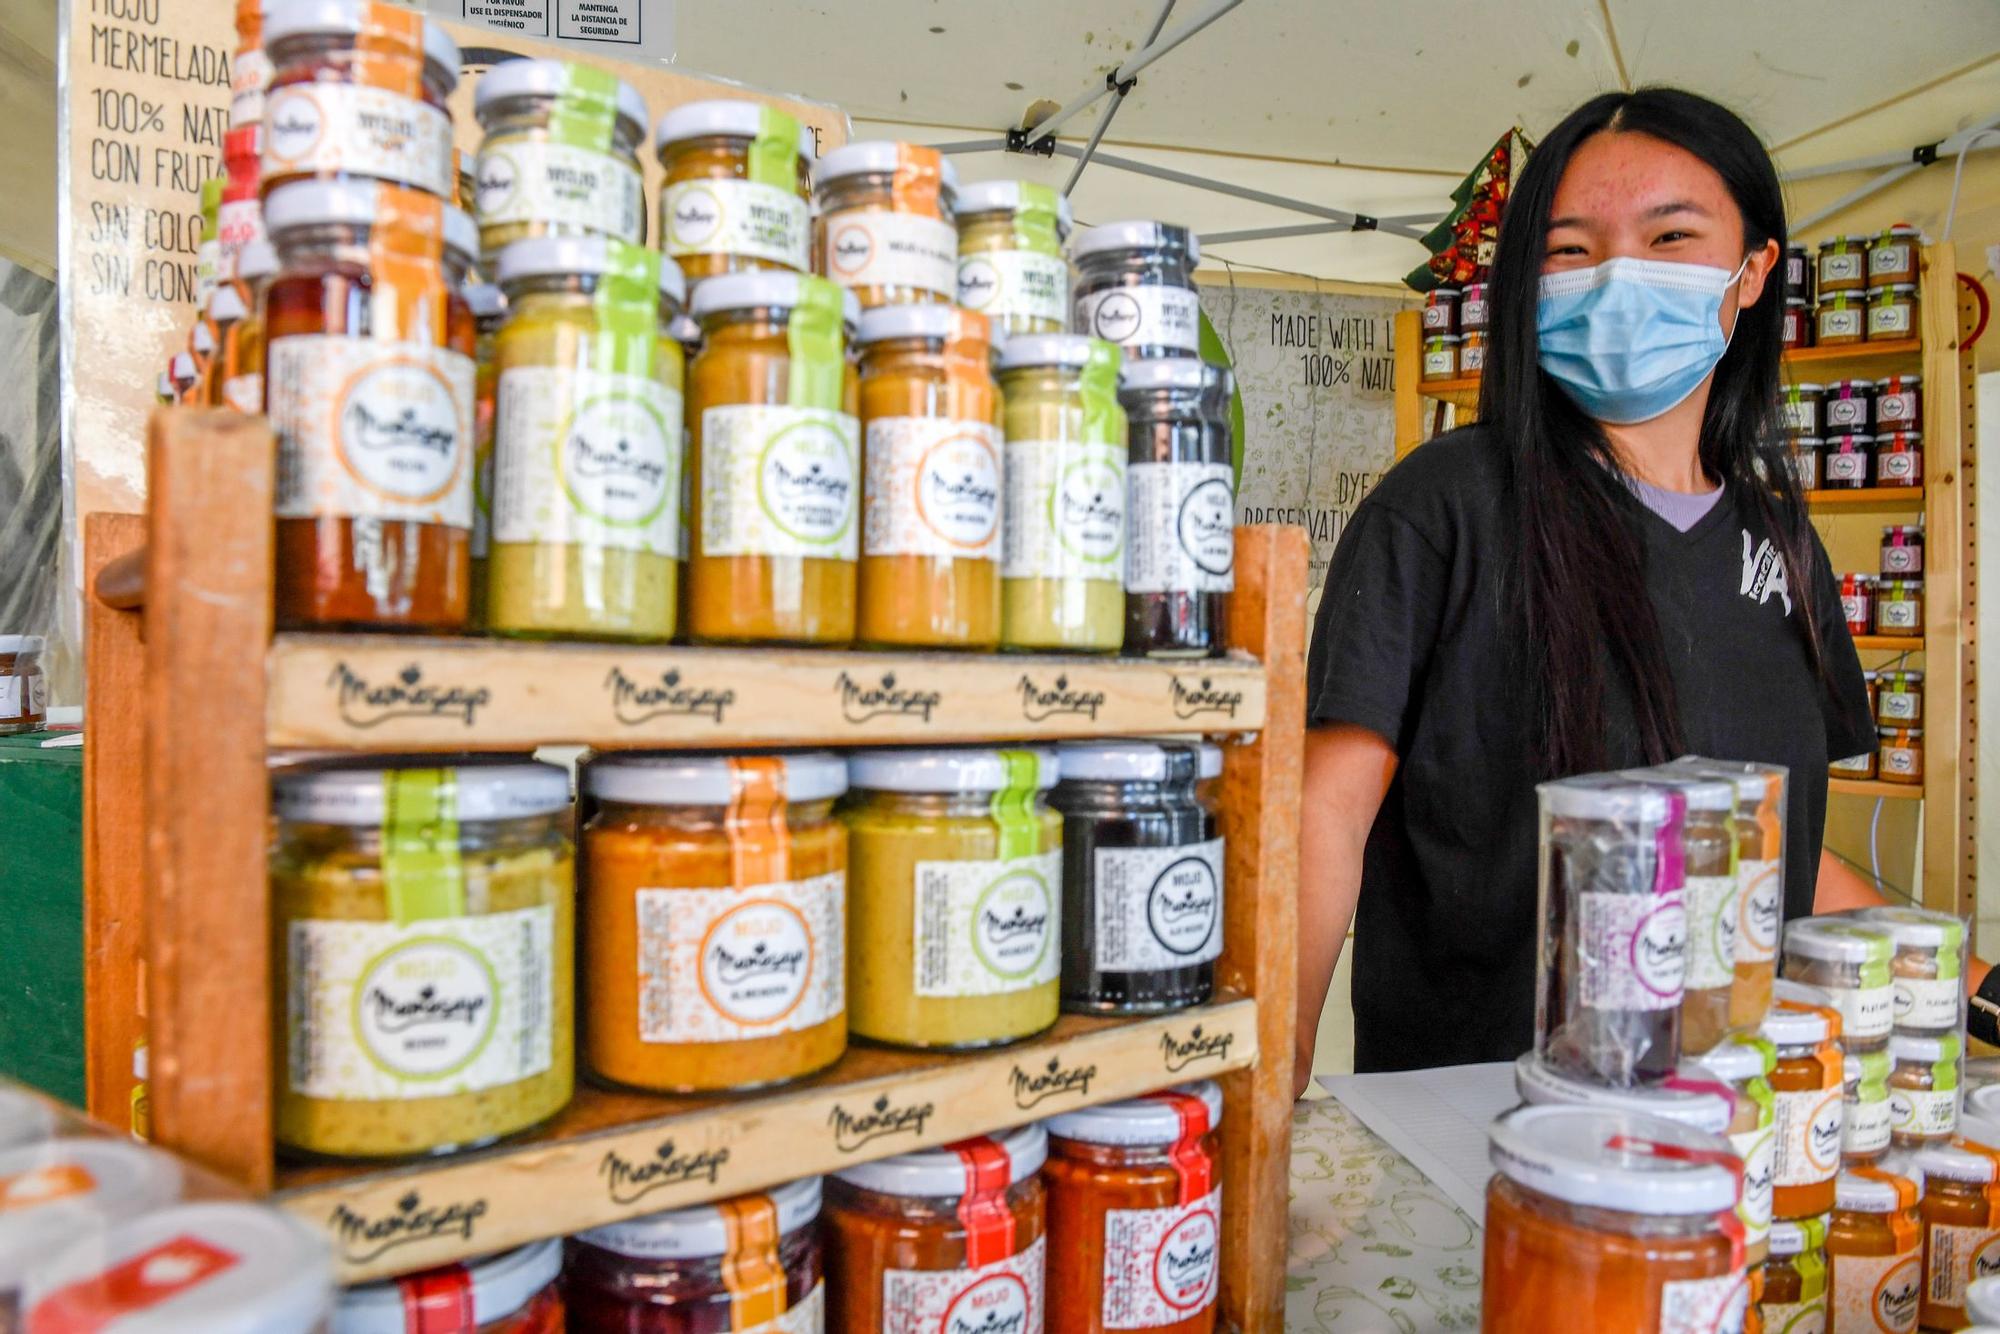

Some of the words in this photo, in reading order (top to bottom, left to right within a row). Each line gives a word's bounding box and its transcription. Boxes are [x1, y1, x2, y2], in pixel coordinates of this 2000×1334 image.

[470, 7, 484, 15] USE
[493, 8, 542, 19] DISPENSADOR
[571, 14, 580, 22] LA
[581, 15, 618, 25] DISTANCIA
[619, 17, 627, 25] DE
[578, 3, 618, 13] MANTENGA
[580, 26, 619, 36] SEGURIDAD
[91, 88, 164, 134] 100%
[92, 138, 140, 184] CON
[91, 201, 129, 242] SIN
[91, 252, 129, 297] SIN
[1271, 313, 1316, 348] MADE
[1329, 317, 1374, 351] WITH
[1301, 354, 1350, 387] 100%
